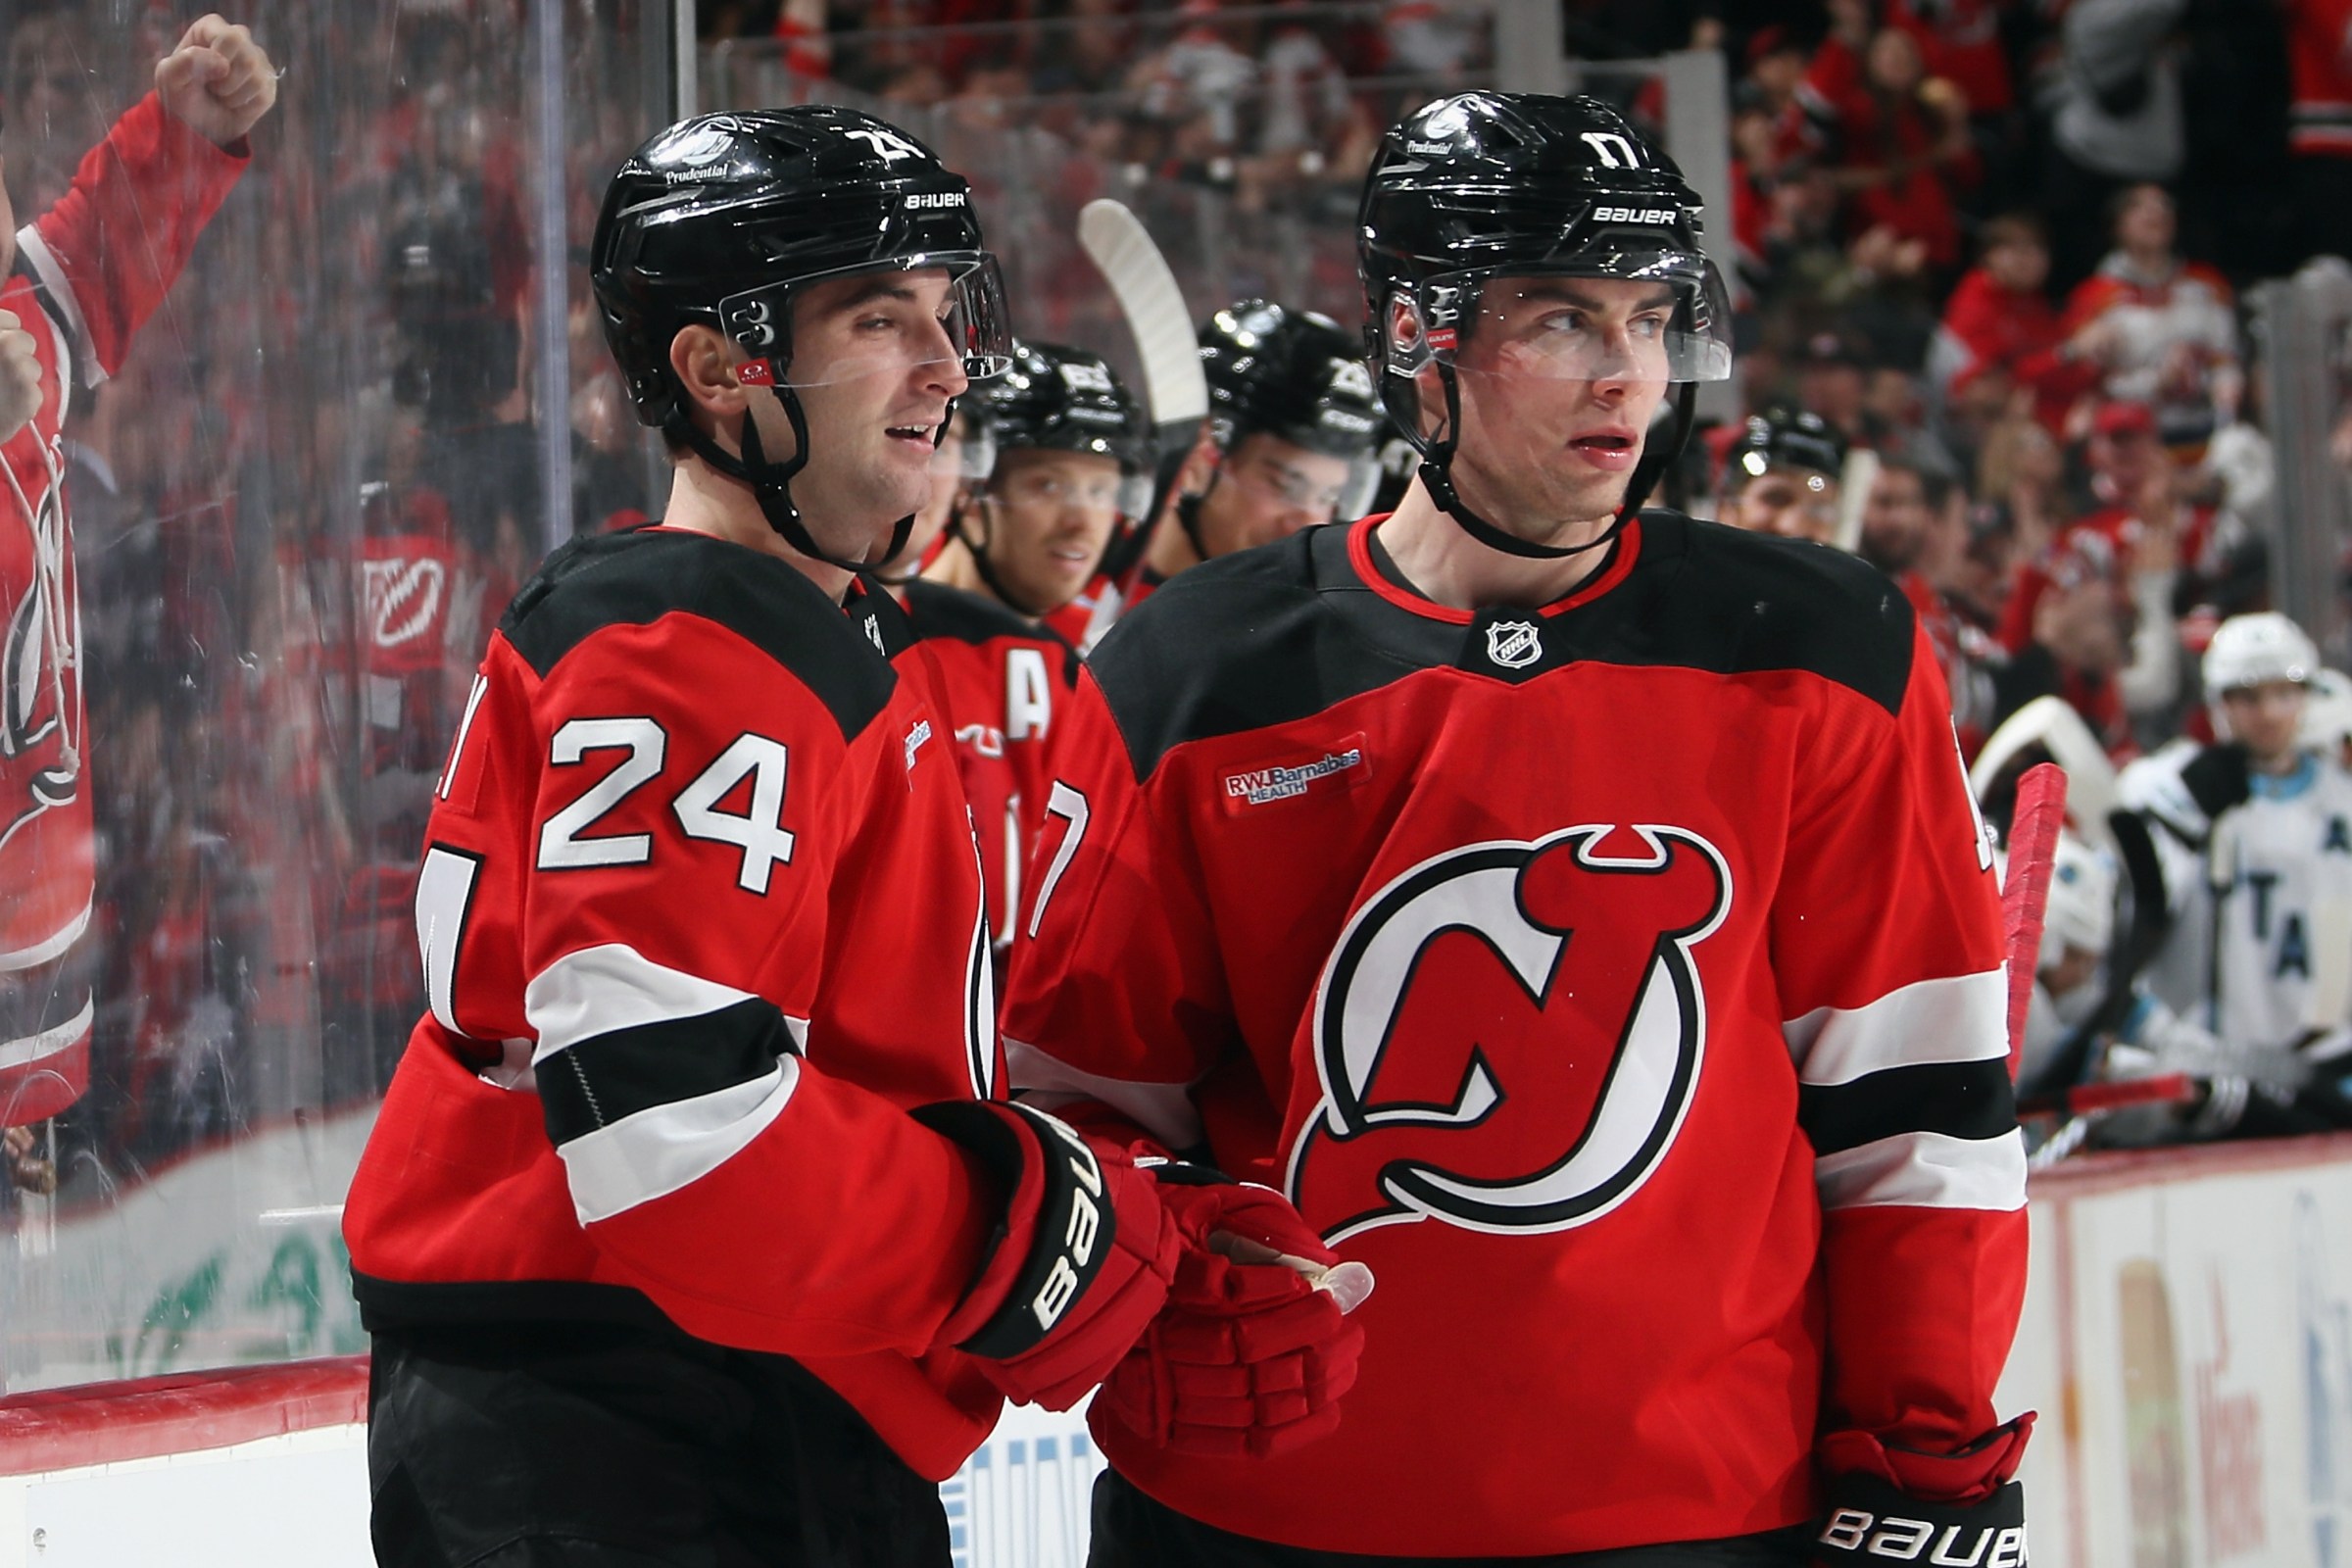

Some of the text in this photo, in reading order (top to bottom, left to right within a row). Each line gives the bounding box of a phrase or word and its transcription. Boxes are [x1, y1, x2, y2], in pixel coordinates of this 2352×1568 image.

[844, 129, 926, 161] 24
[1580, 131, 1641, 169] 17
[665, 164, 729, 184] Prudential
[904, 192, 966, 210] BAUER
[1592, 206, 1677, 225] BAUER
[1499, 633, 1530, 660] NHL
[1005, 648, 1052, 741] A
[1227, 748, 1362, 796] RWJBarnabas
[534, 715, 797, 899] 24
[1249, 780, 1307, 805] HEALTH
[1028, 778, 1090, 939] 7
